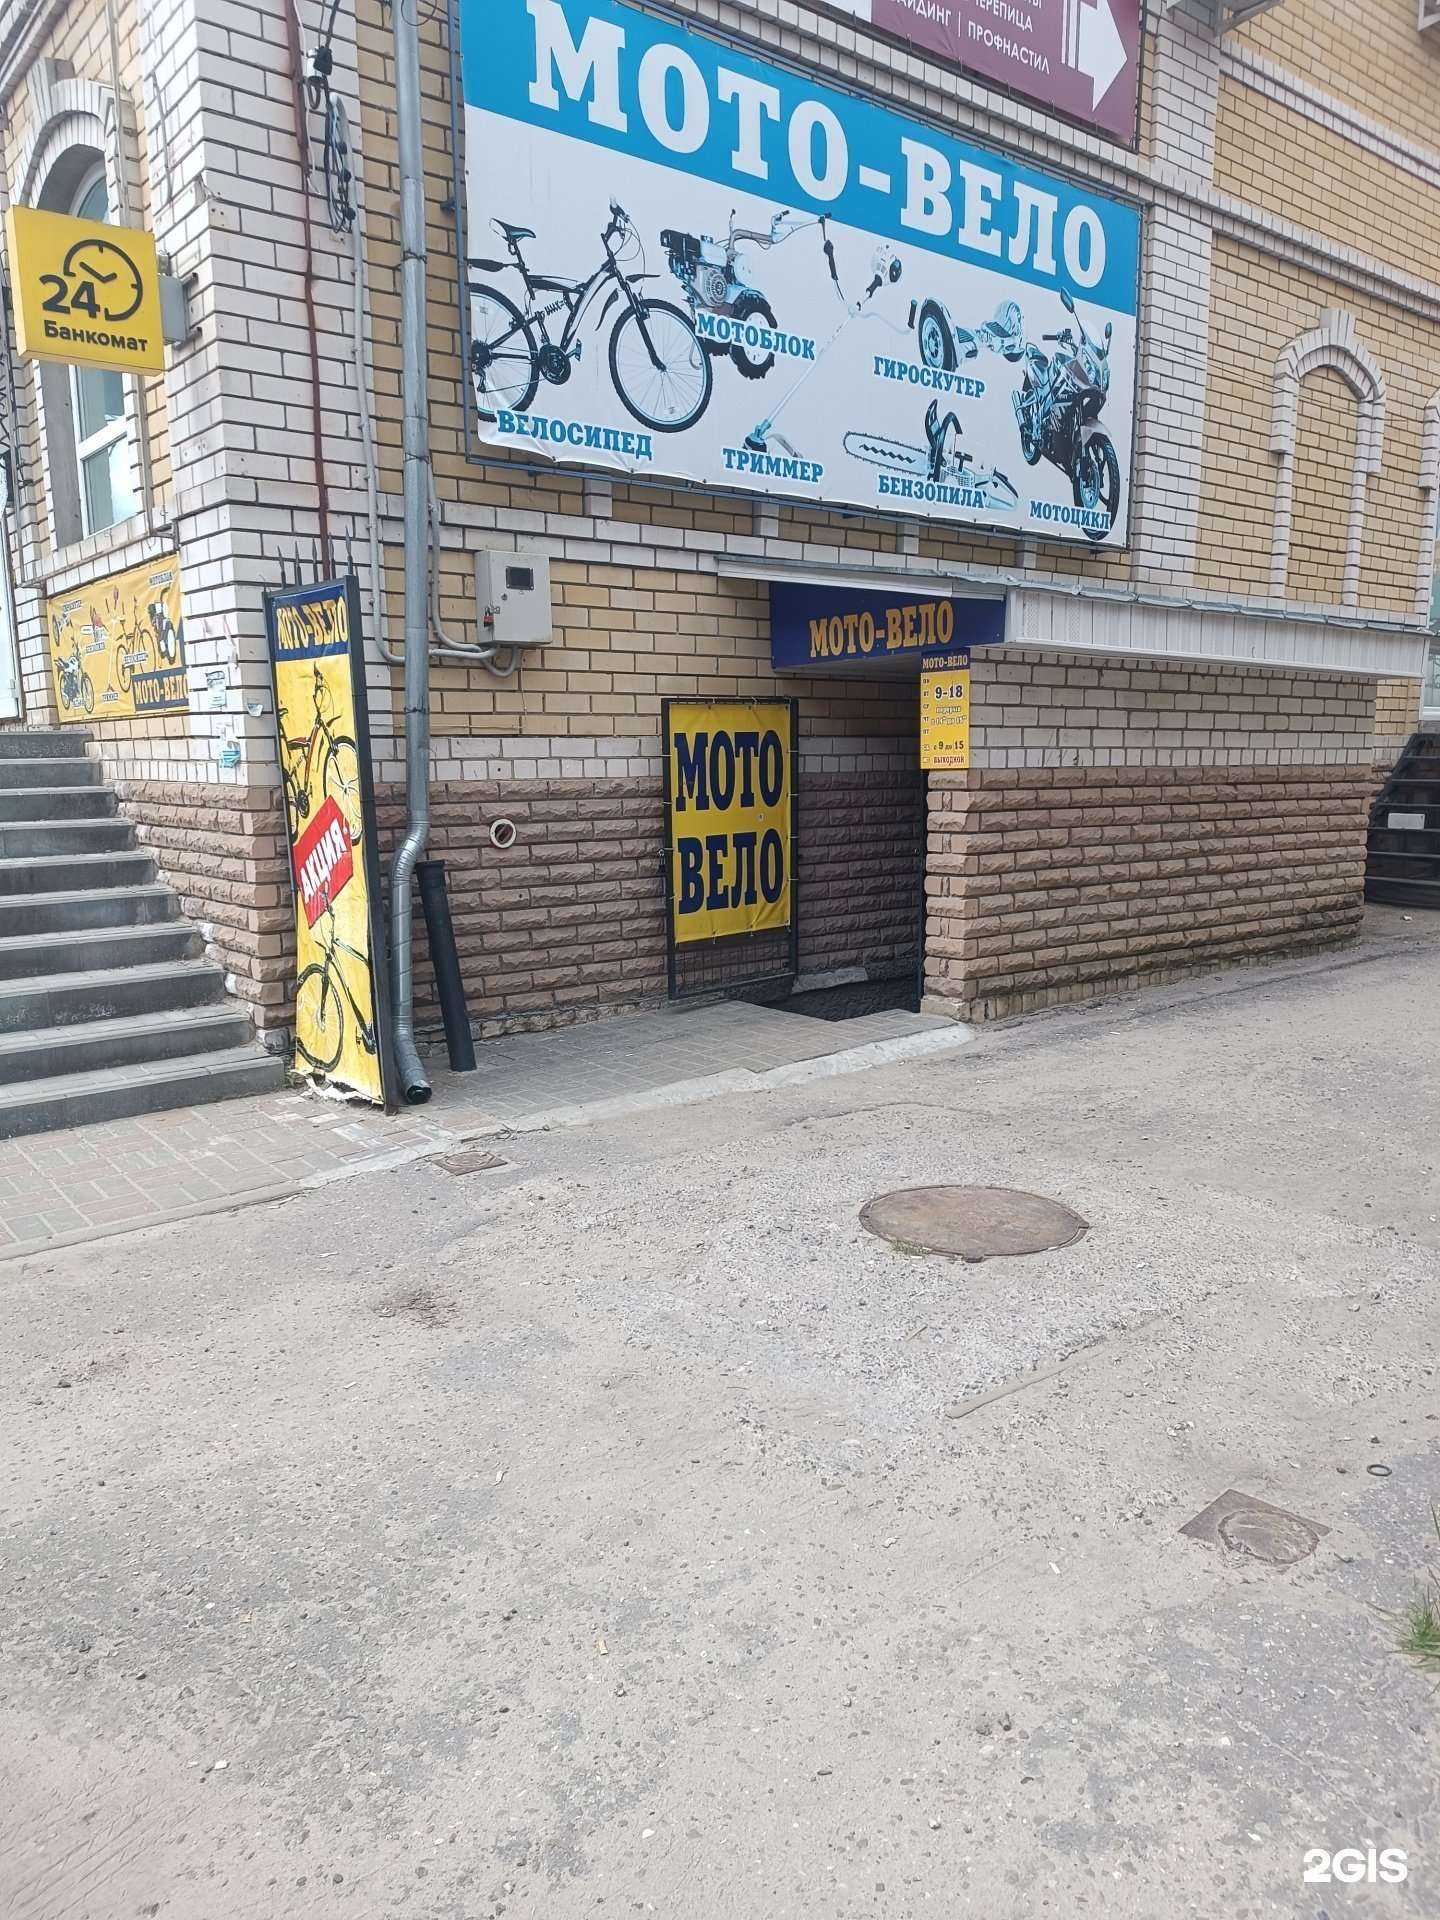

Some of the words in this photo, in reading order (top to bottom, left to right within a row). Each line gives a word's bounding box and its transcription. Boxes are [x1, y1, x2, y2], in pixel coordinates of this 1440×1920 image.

[968, 21, 1050, 75] ПРОФНАСТИЛ
[526, 0, 1106, 289] МОТО-ВЕЛО
[39, 274, 100, 318] 24
[43, 319, 148, 352] Банкомат
[698, 313, 816, 360] МОТОБЛОК
[873, 356, 986, 399] ГИРОСКУТЕР
[497, 410, 653, 461] ВЕЛОСИПЕД
[723, 448, 824, 483] ТРИММЕР
[878, 474, 986, 509] БЕНЗОПИЛА
[1030, 500, 1111, 530] МОТОЦИКЛ
[809, 600, 954, 658] МОТО-ВЕЛО
[923, 654, 968, 669] МОТО-ВЕЛО
[935, 685, 963, 699] 9-18
[938, 741, 944, 750] 9
[955, 740, 964, 750] 15
[674, 730, 784, 812] МОТО
[300, 818, 347, 904] АКЦИЯ
[677, 828, 784, 915] ВЕЛО
